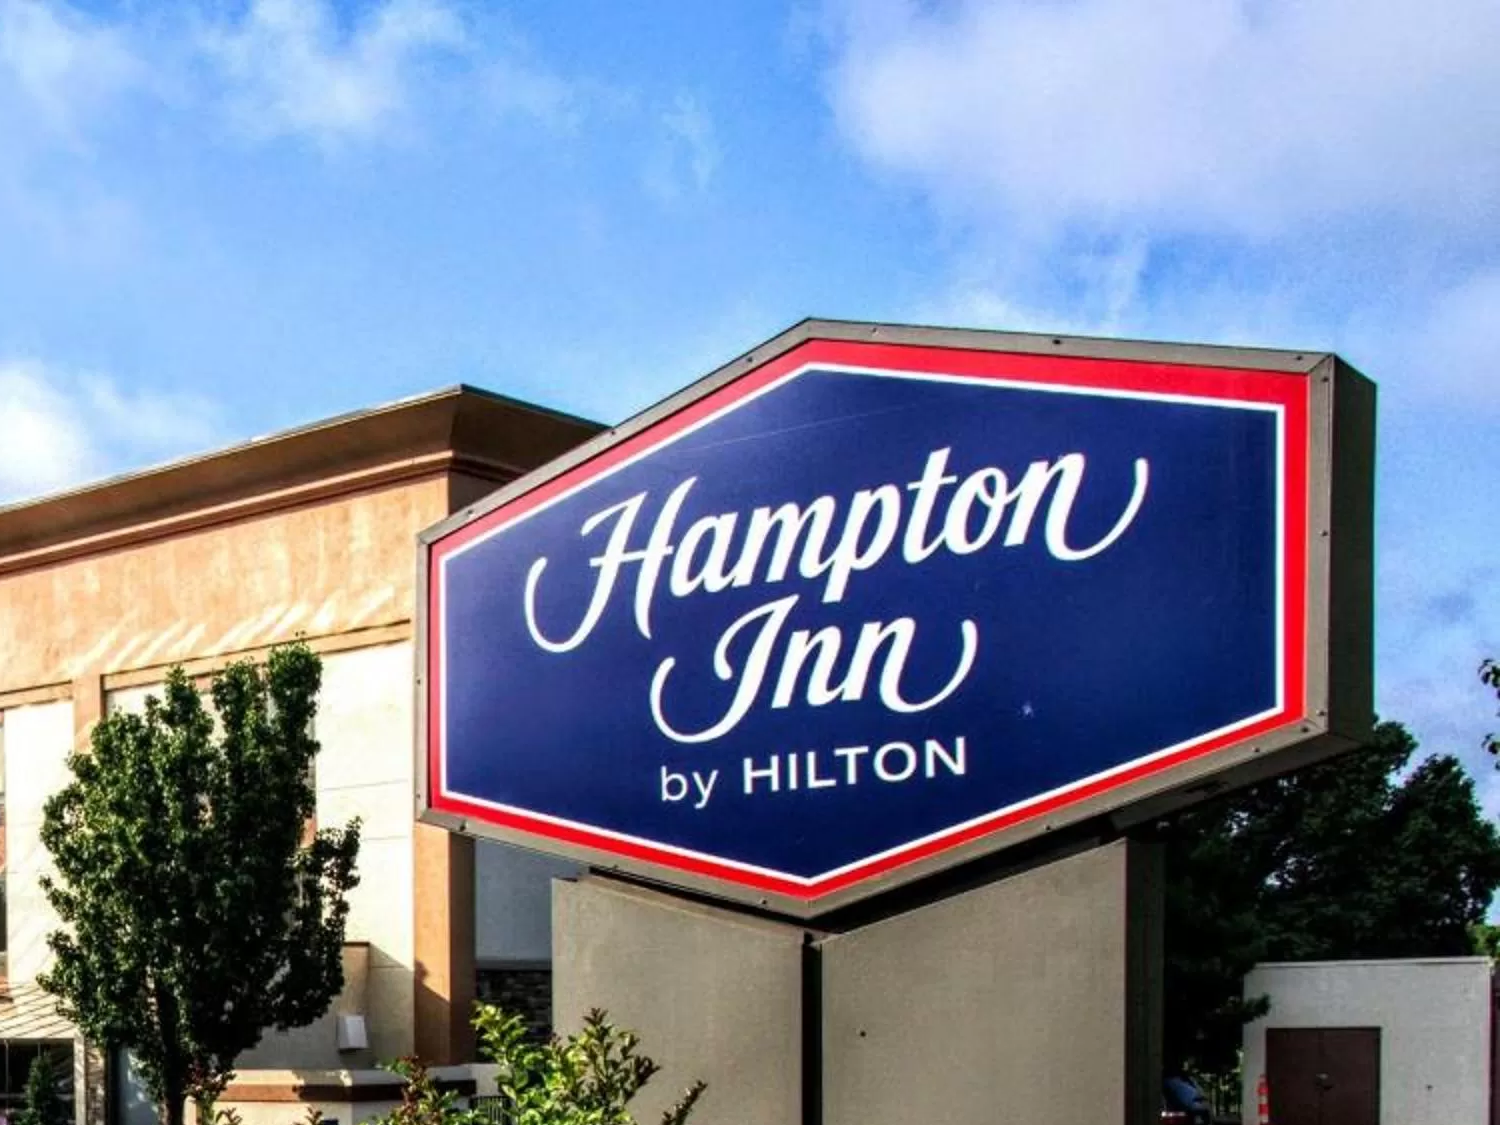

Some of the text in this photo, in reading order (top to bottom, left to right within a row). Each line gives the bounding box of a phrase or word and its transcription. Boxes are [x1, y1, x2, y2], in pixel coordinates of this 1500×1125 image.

[525, 446, 1149, 653] Hampton
[649, 594, 979, 744] Inn
[659, 735, 967, 810] by HILTON
